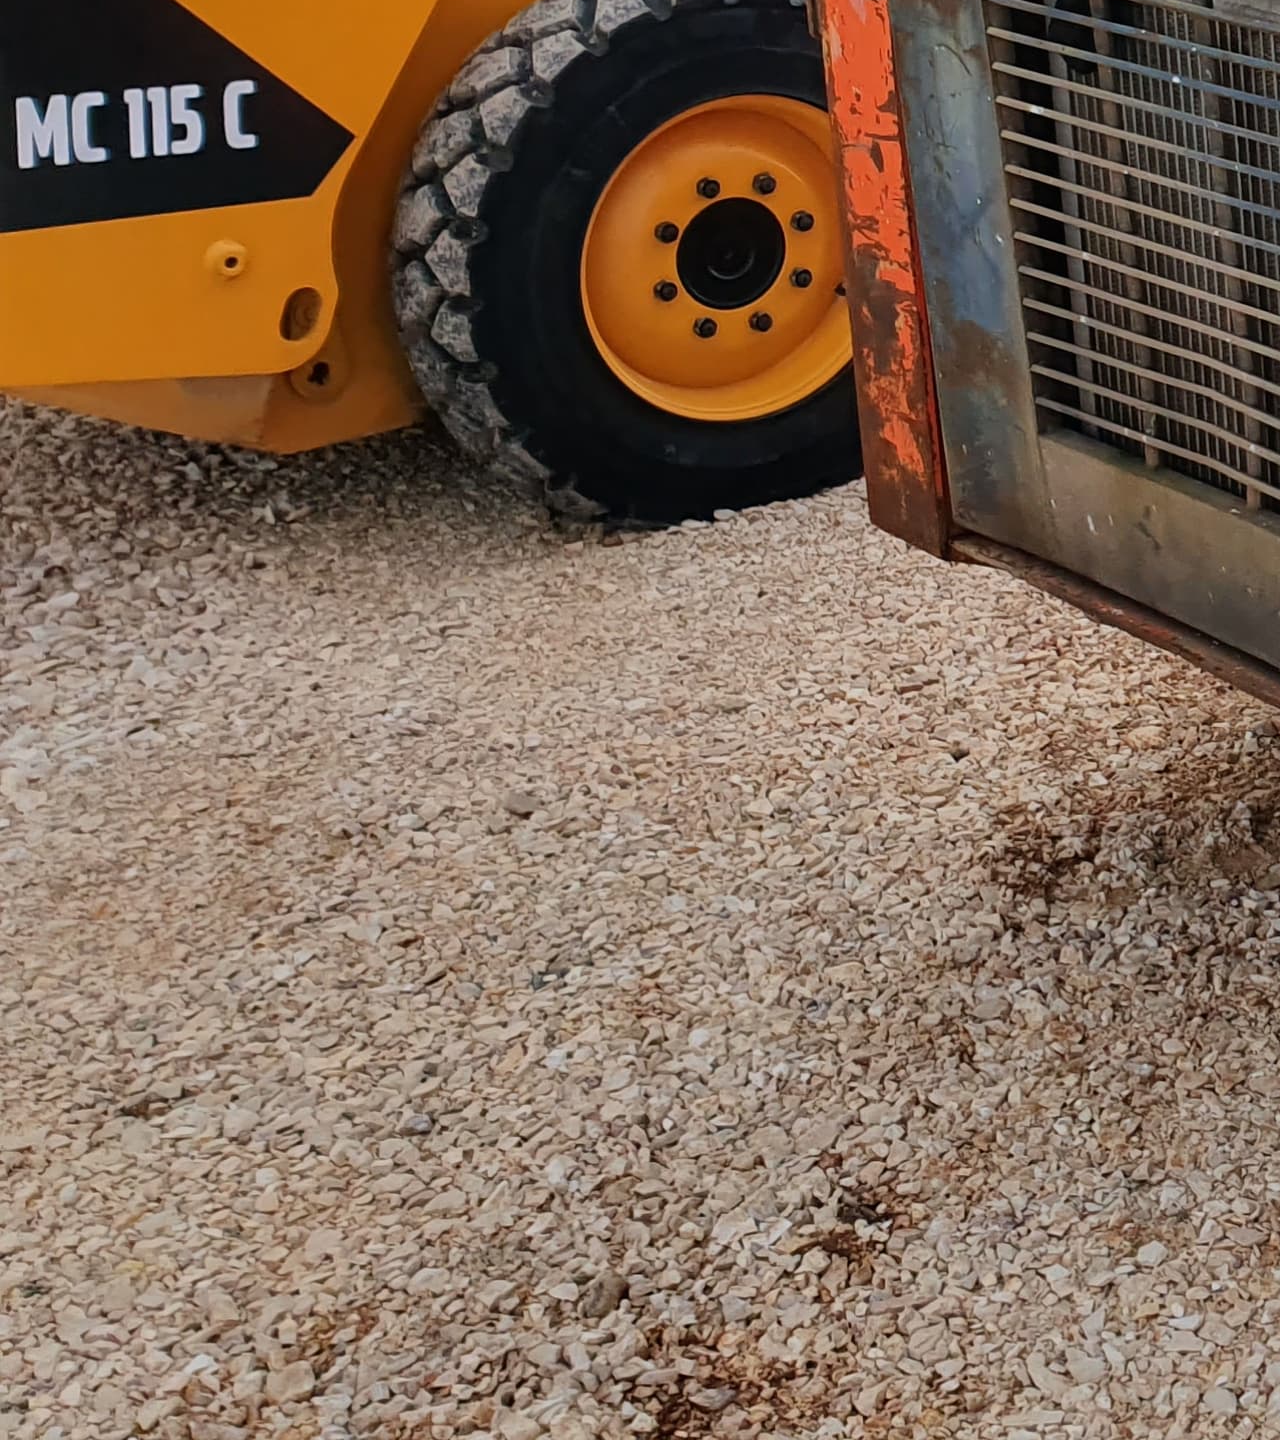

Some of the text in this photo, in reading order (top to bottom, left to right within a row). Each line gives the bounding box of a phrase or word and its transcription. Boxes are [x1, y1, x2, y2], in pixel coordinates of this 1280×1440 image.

[15, 79, 258, 169] MC 115 C
